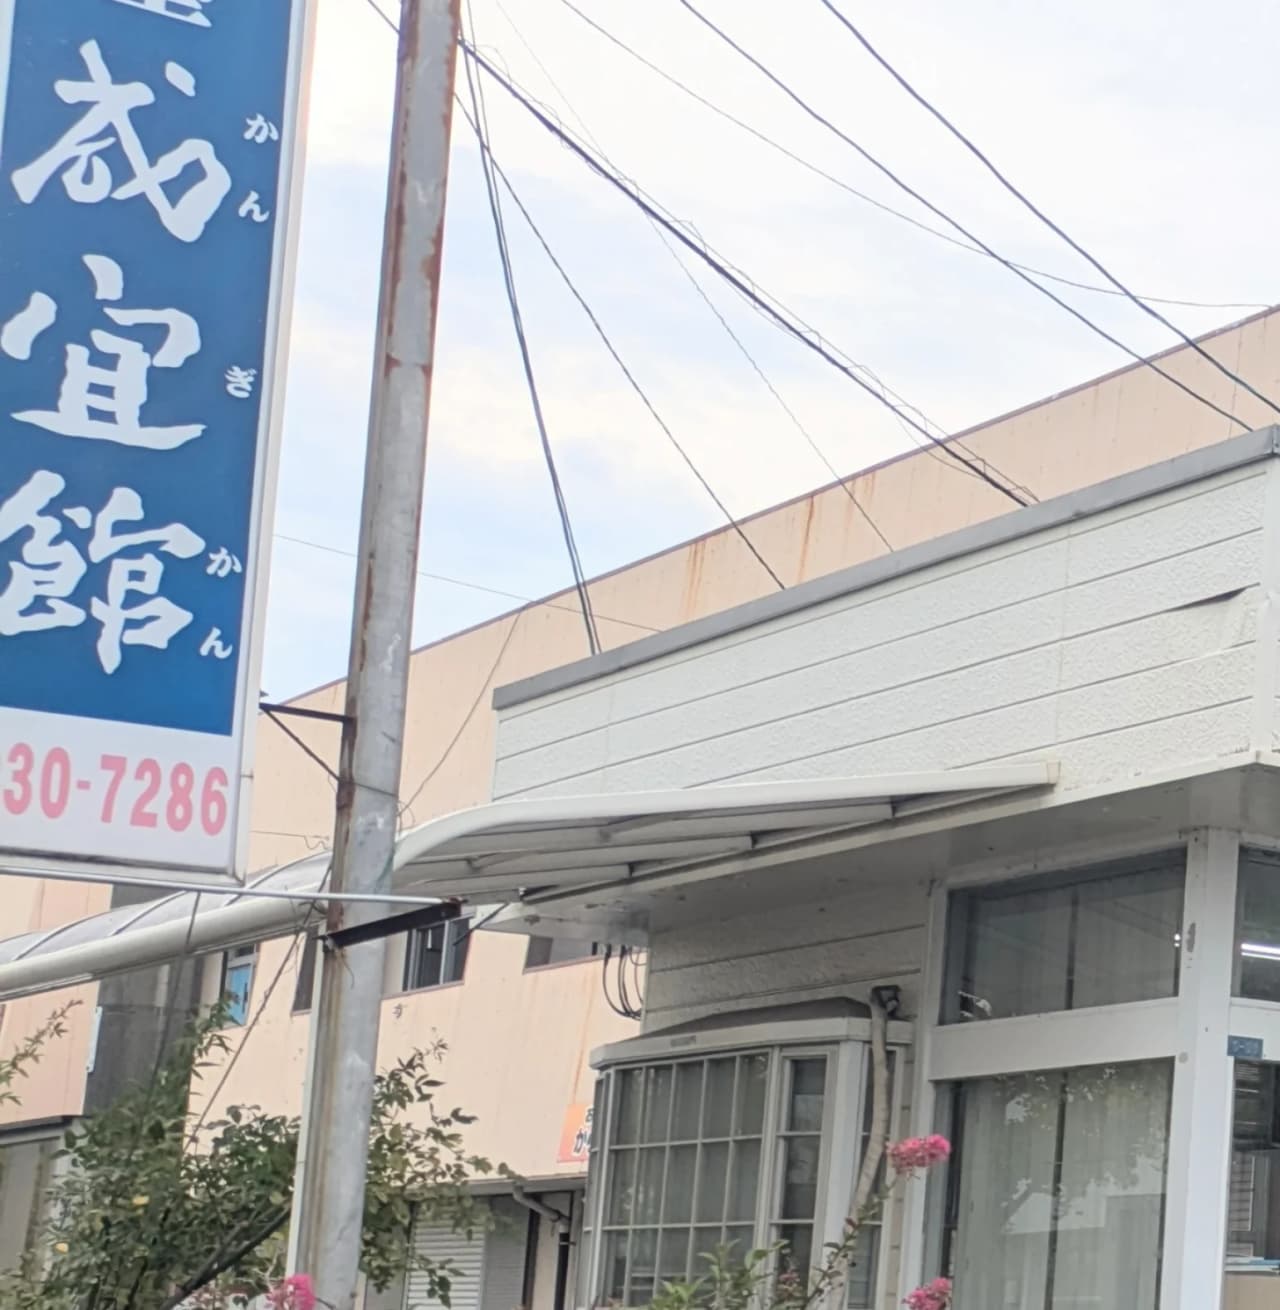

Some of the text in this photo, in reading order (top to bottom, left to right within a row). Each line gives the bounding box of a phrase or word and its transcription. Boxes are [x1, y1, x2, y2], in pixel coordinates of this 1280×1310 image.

[236, 113, 280, 225] かん
[225, 367, 256, 399] ぎ
[199, 546, 243, 660] かん
[3, 743, 229, 836] 30-7286
